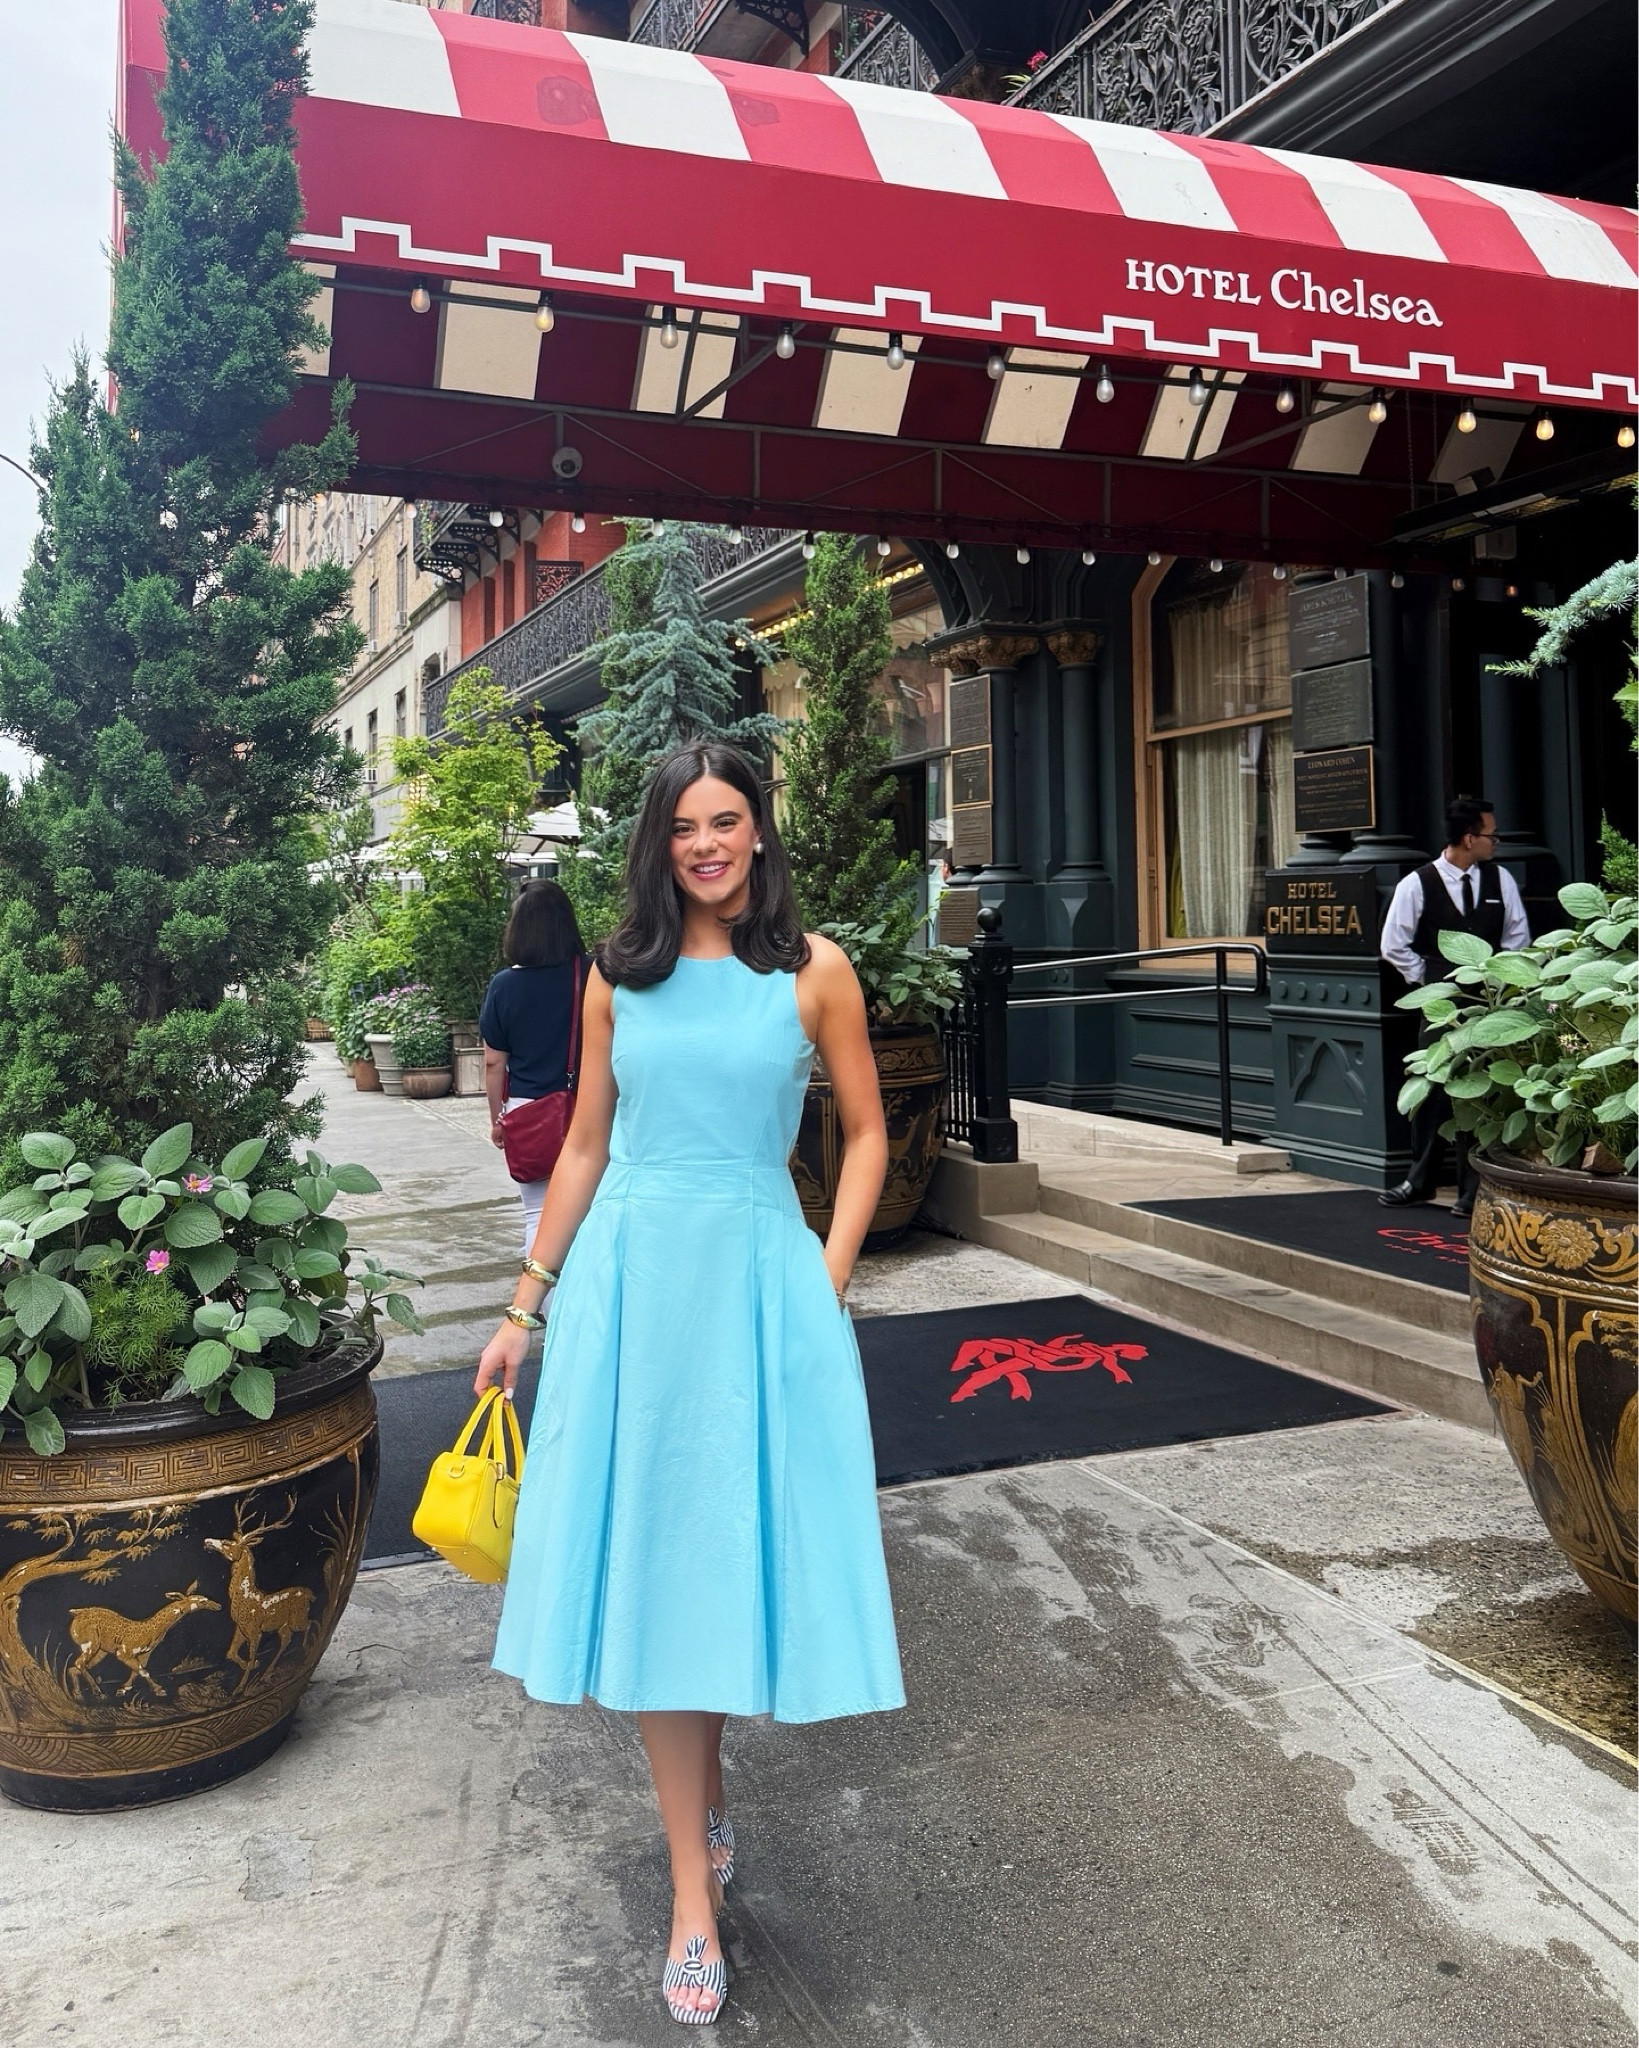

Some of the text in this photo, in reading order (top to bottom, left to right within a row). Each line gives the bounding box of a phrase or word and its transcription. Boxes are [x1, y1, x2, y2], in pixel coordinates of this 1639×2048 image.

[1125, 258, 1444, 328] HOTEL Chelsea
[1287, 882, 1337, 899] HOTEL
[1266, 905, 1362, 935] CHELSEA
